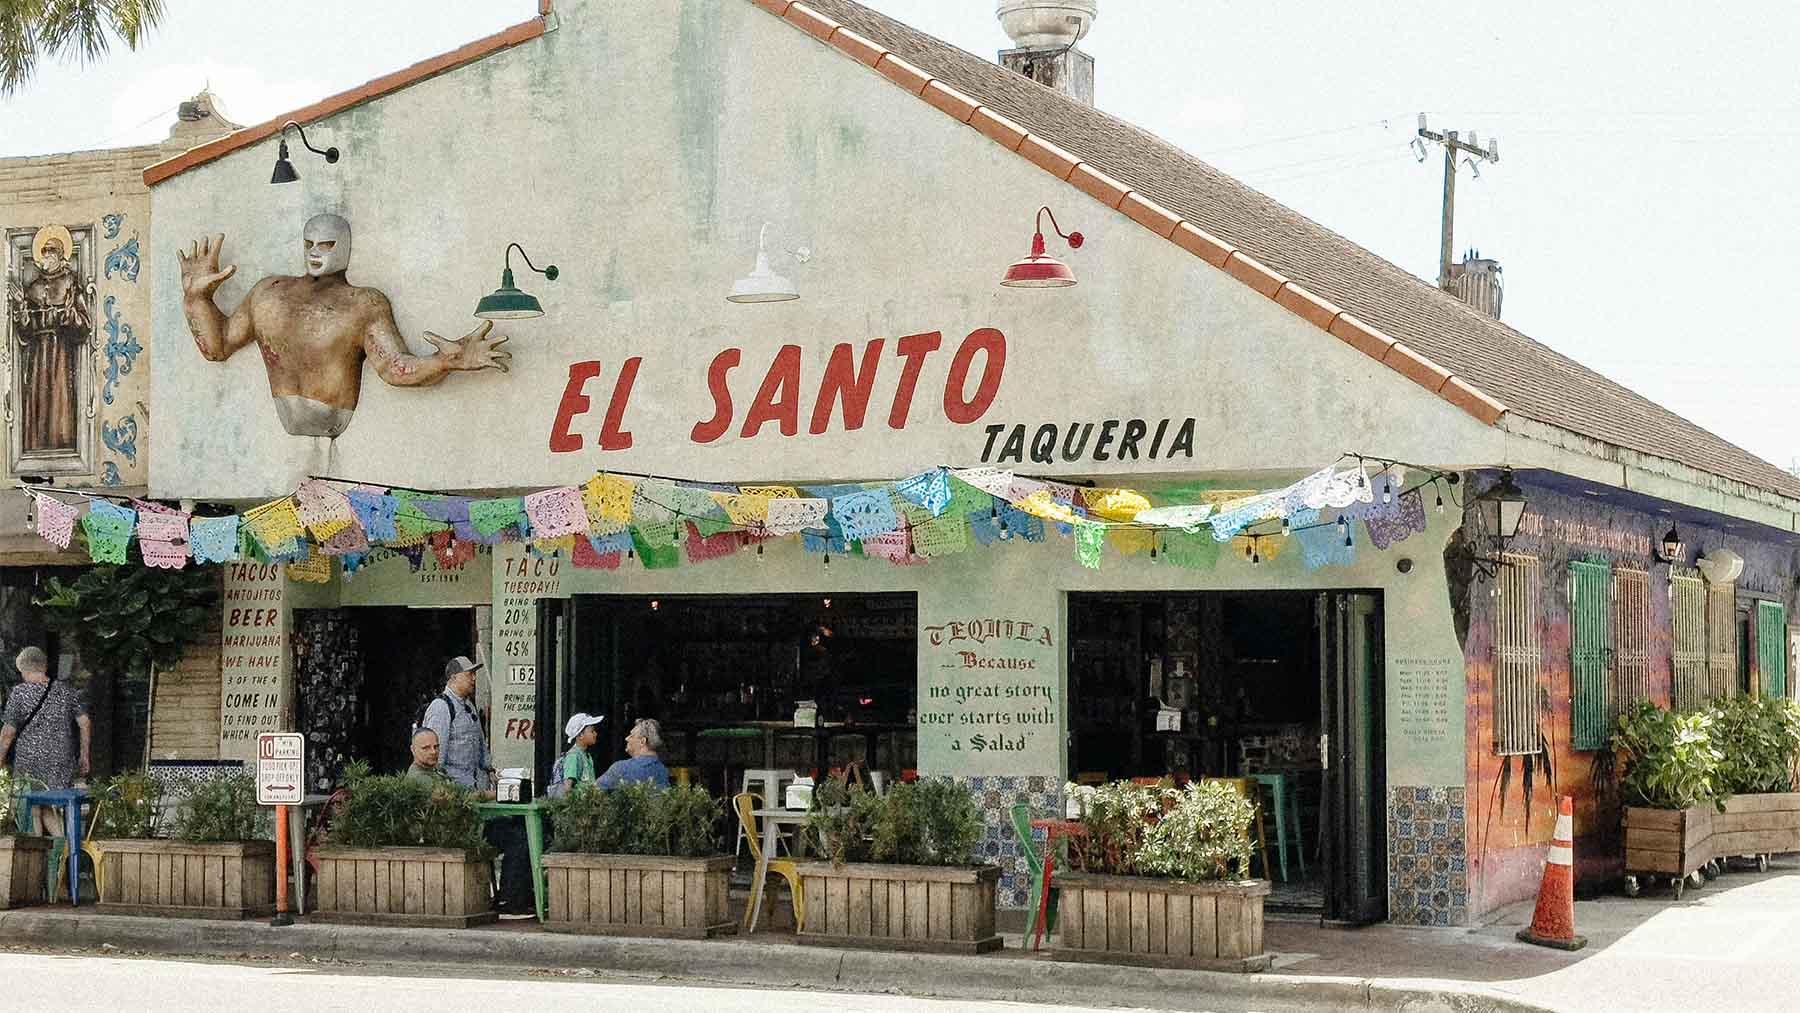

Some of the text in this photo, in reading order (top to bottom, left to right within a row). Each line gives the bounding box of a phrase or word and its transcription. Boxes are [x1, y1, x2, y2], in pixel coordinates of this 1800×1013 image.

[549, 327, 1007, 453] EL SANTO
[980, 418, 1196, 465] TAQUERIA
[230, 563, 278, 581] TACOS
[505, 557, 559, 576] TACO
[227, 589, 281, 601] ANTOJITOS
[504, 581, 560, 594] TUESDAY!!
[503, 598, 529, 607] BRING
[229, 608, 278, 627] BEER
[504, 609, 529, 625] 20%
[499, 629, 524, 638] BRING
[924, 619, 1054, 647] TEQUILA
[223, 635, 281, 648] MARIJUANA
[505, 641, 529, 656] 45%
[225, 656, 279, 668] WE HAVE
[236, 676, 247, 685] OF
[252, 676, 268, 685] THE
[511, 667, 535, 682] 162
[226, 693, 278, 708] COME IN
[929, 684, 1053, 705] no great story
[223, 715, 278, 726] TO FIND OUT
[920, 706, 1054, 725] ever starts with
[222, 729, 250, 741] WHICH
[260, 740, 274, 757] 10
